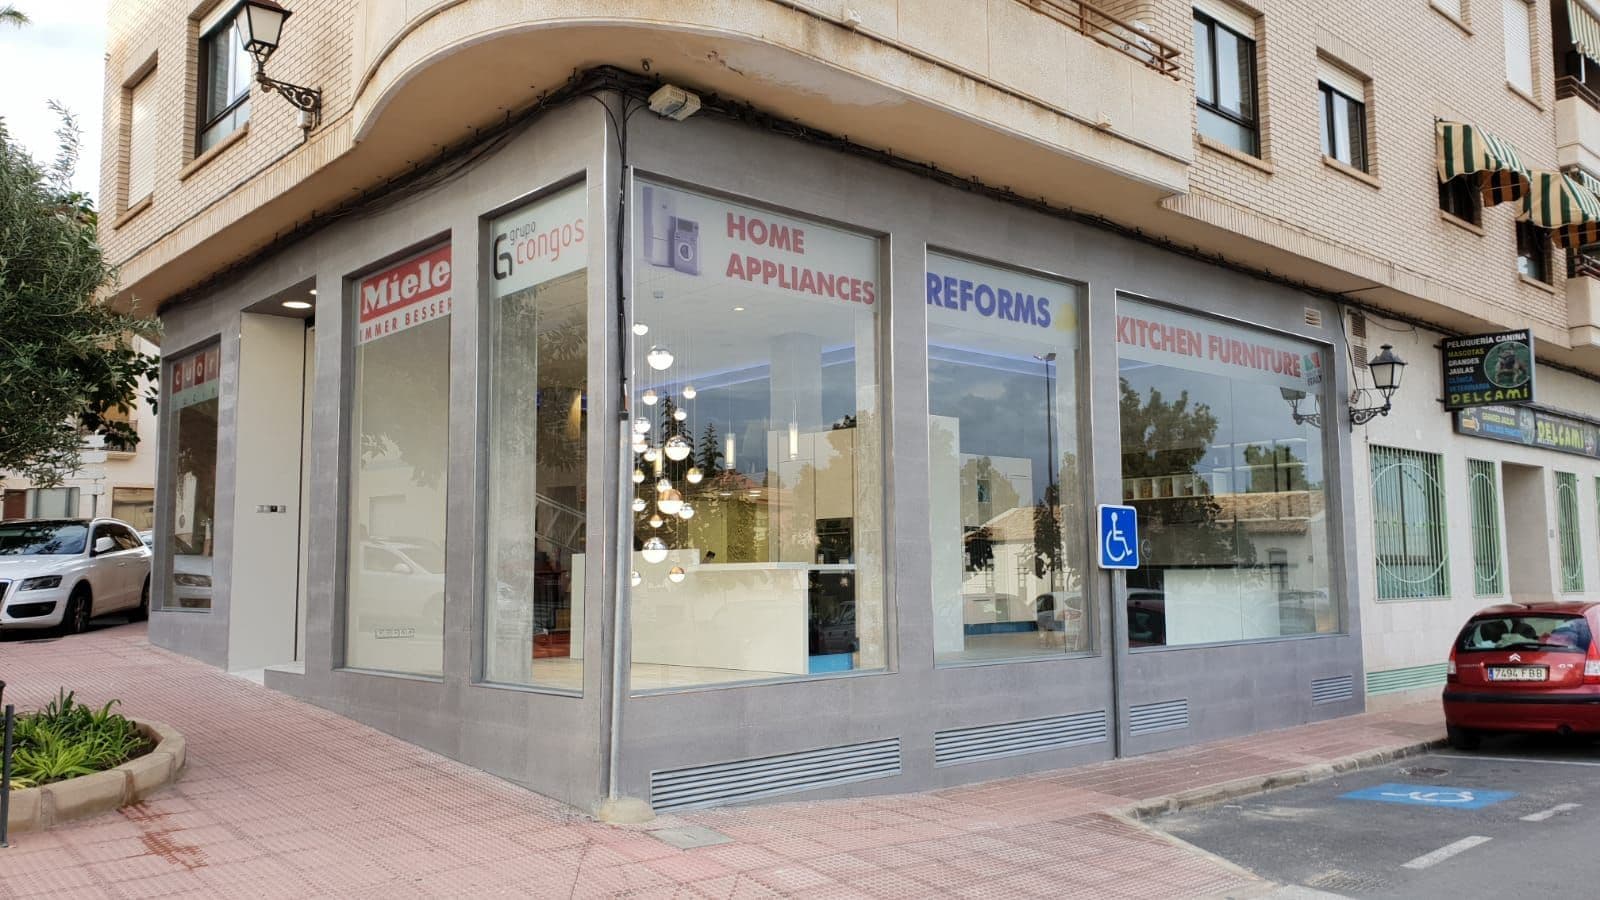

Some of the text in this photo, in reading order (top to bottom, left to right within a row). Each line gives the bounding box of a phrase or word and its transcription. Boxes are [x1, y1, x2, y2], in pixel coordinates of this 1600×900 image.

[508, 221, 536, 246] grupo
[516, 218, 585, 265] congos
[726, 212, 805, 255] HOME
[362, 259, 451, 314] Miele
[725, 253, 875, 305] APPLIANCES
[926, 271, 1051, 328] REFORMS
[1116, 315, 1301, 378] KITCHEN FURNITURE
[1496, 332, 1527, 342] CANINA
[1448, 366, 1474, 375] JAULAS
